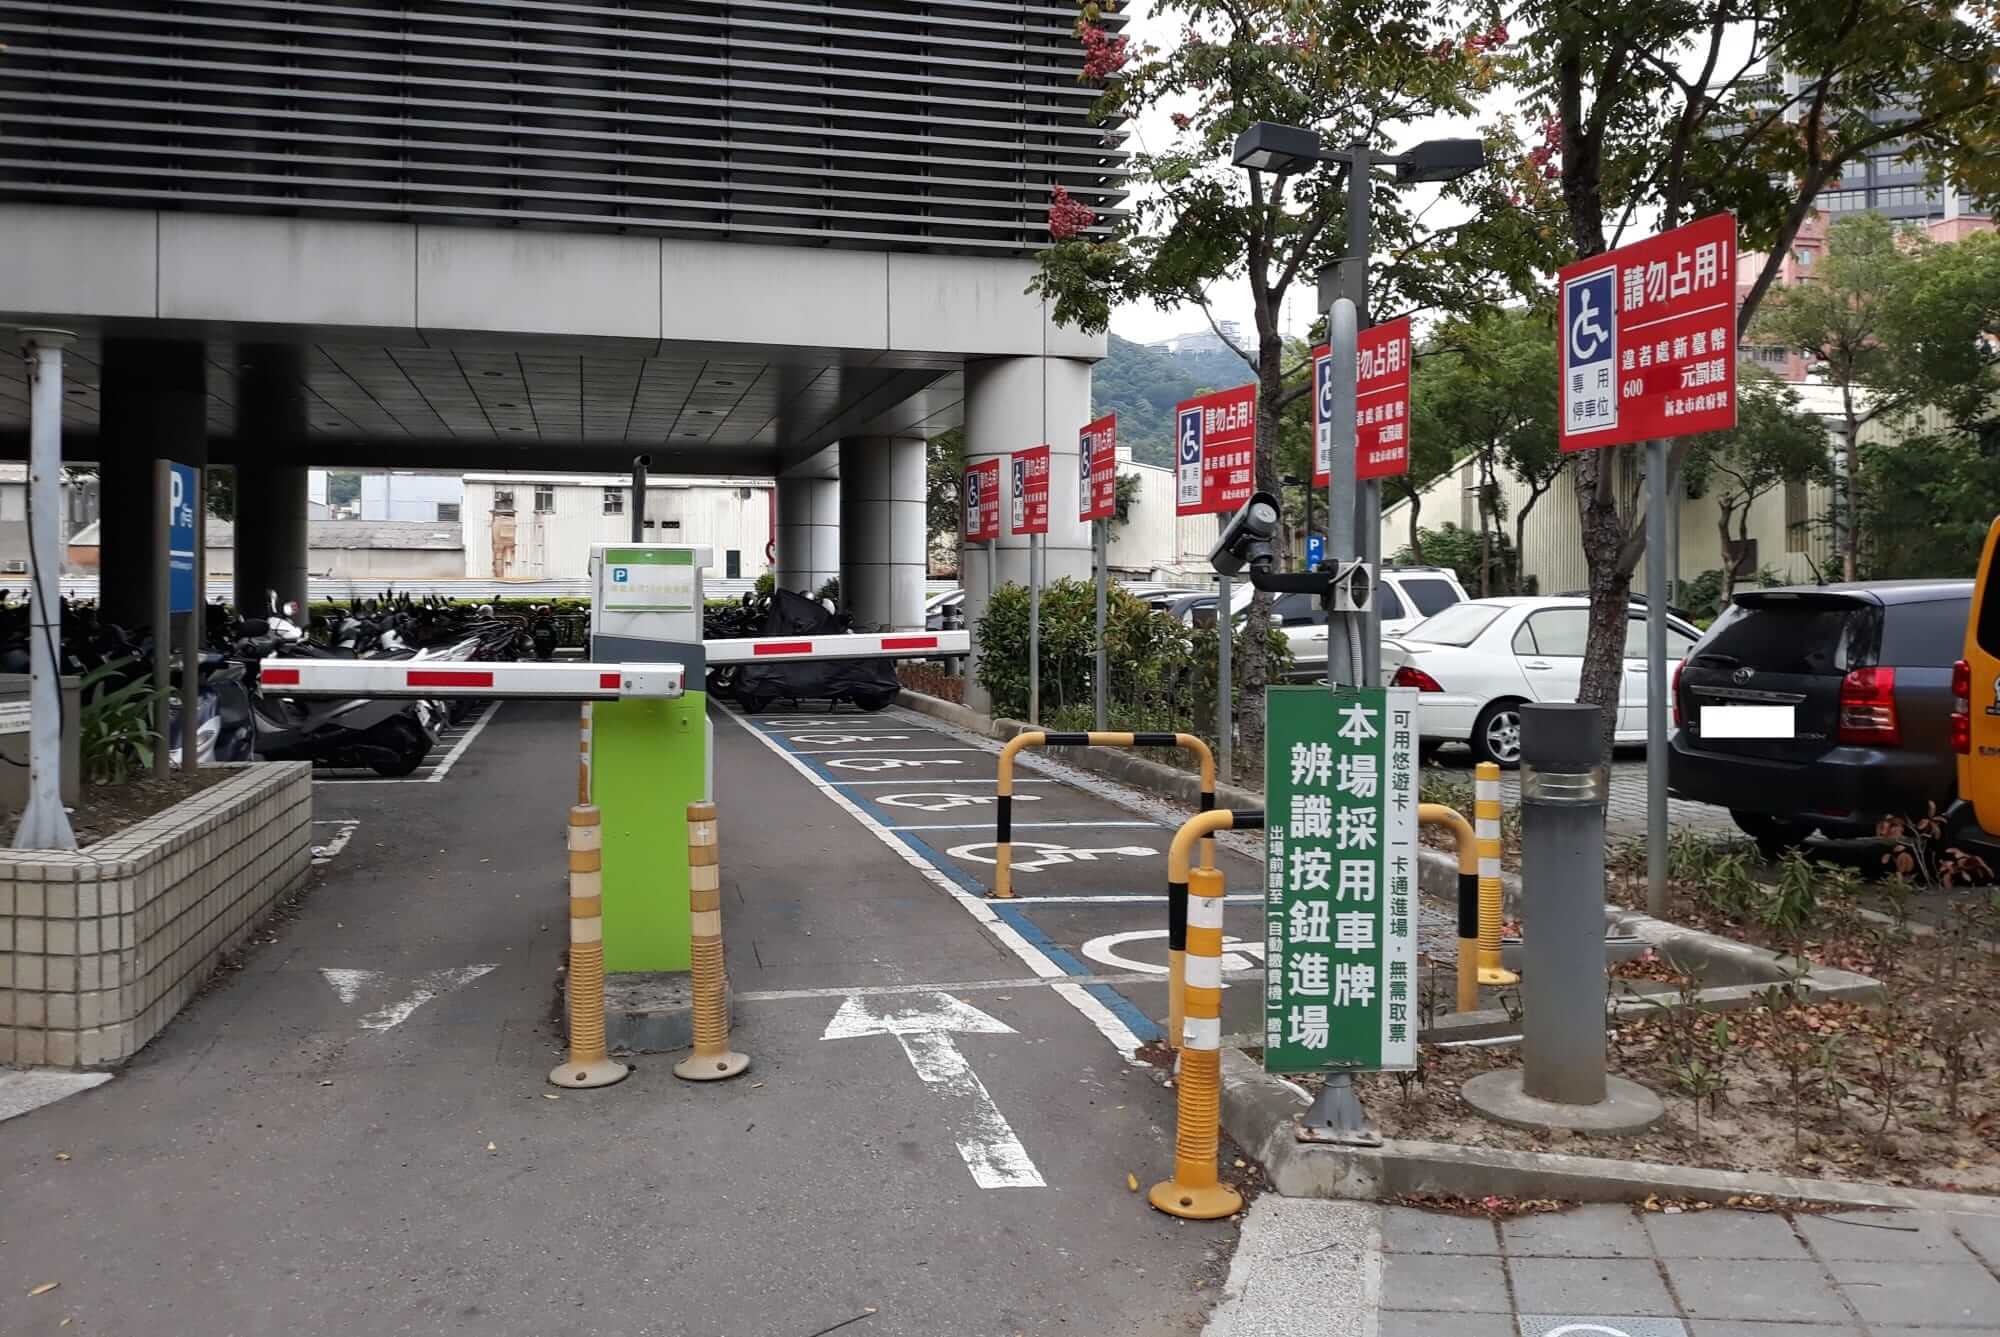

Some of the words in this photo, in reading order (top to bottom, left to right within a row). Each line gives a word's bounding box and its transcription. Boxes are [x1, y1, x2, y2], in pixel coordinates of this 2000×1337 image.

[1623, 240, 1728, 312] 請勿占用!
[1623, 378, 1644, 399] 600
[170, 470, 183, 527] P
[1309, 538, 1320, 551] P
[615, 569, 627, 582] P
[1332, 702, 1379, 1009] 本場採用車牌
[1287, 741, 1334, 1051] 辨識按鈕進場
